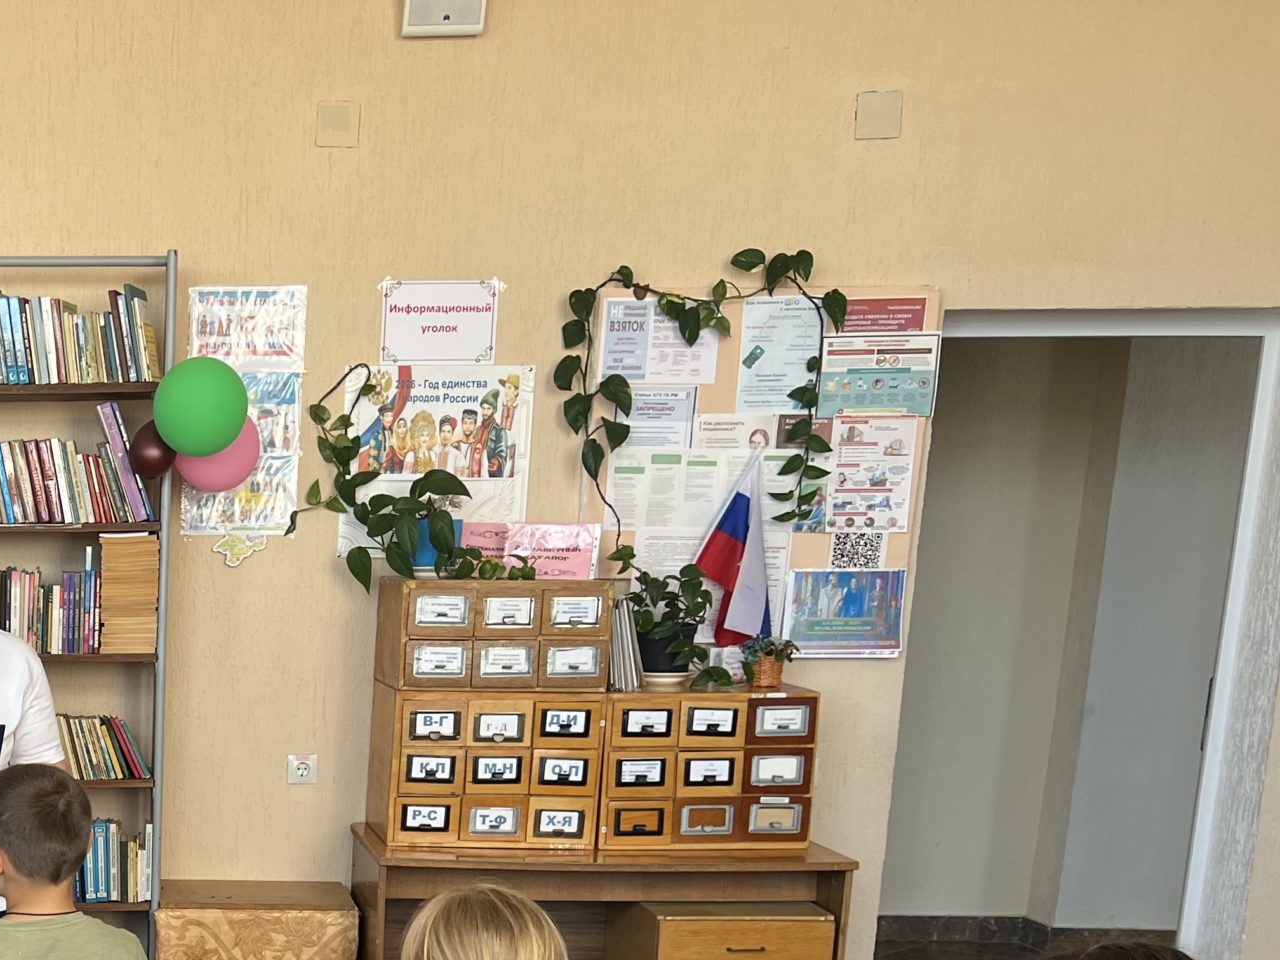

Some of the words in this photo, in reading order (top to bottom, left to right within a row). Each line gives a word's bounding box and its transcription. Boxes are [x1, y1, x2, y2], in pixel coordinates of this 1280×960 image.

[389, 302, 492, 316] Информационный
[610, 305, 624, 318] НЕ
[421, 324, 458, 335] уголок
[609, 321, 645, 332] ВЗЯТОК
[424, 379, 439, 390] Год
[442, 380, 488, 389] единства
[443, 393, 478, 403] России
[423, 715, 448, 727] В-Г
[548, 714, 578, 727] Д-И
[484, 763, 513, 774] М-Н
[551, 764, 580, 777] О-П
[412, 810, 437, 821] Р-С
[479, 814, 507, 826] Т-Ф
[546, 815, 572, 827] Х-Я
